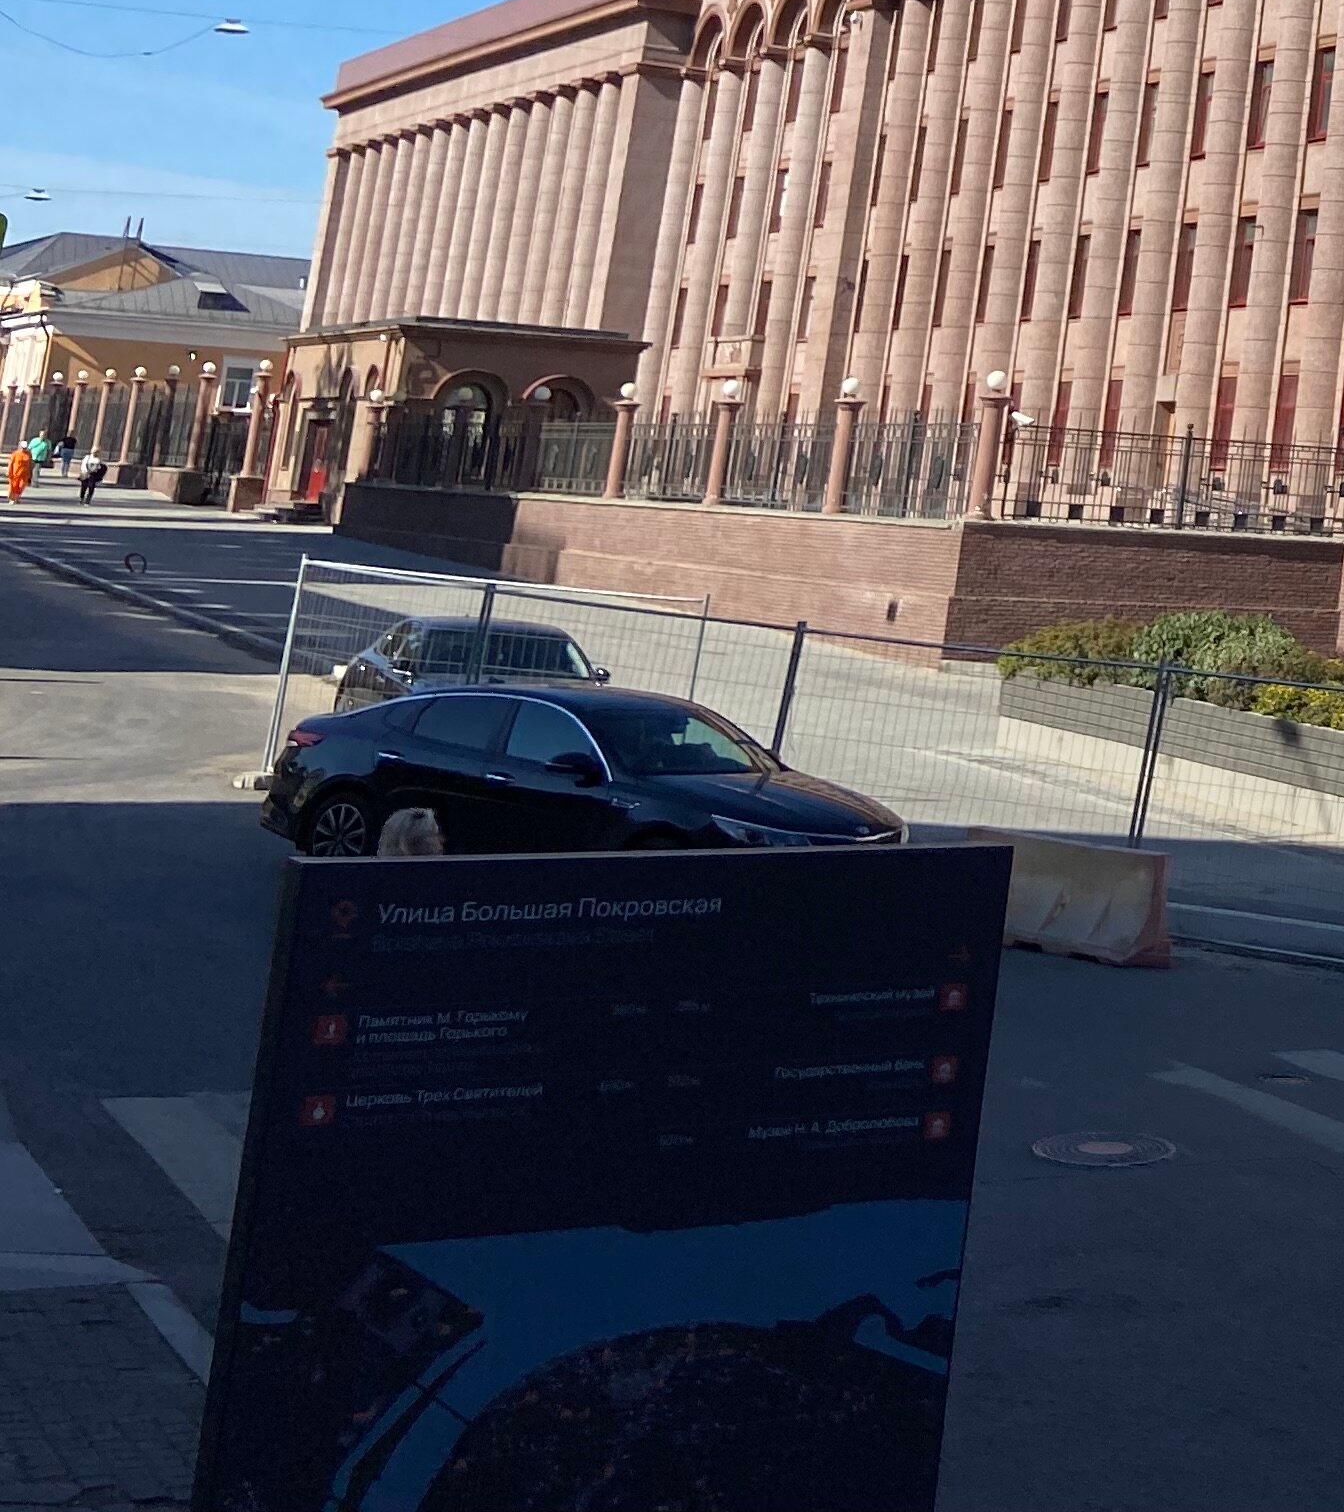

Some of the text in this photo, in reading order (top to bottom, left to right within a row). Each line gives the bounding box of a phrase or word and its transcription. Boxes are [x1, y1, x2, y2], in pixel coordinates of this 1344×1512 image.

[377, 896, 723, 924] Улица Большая Покровская
